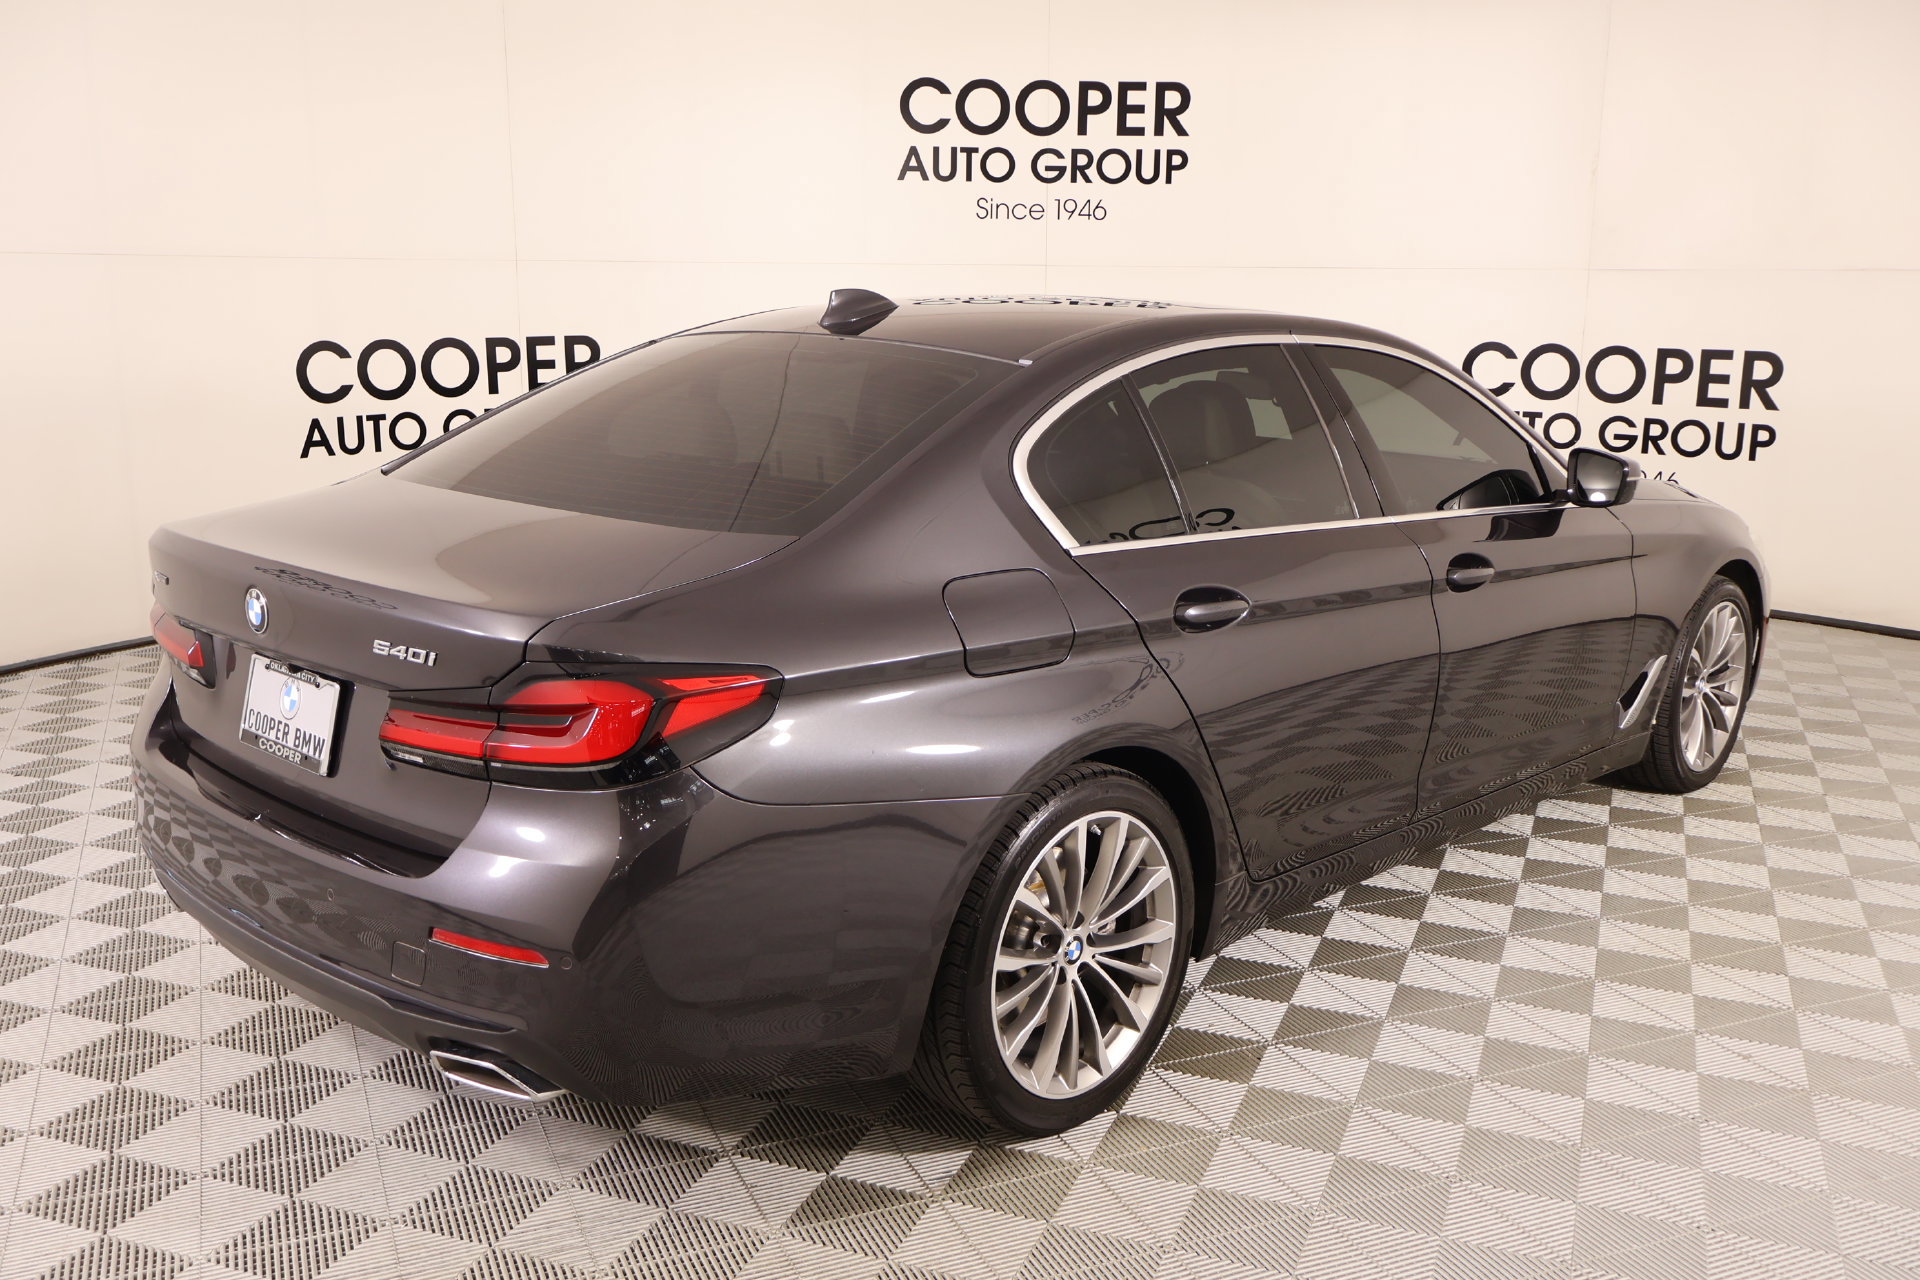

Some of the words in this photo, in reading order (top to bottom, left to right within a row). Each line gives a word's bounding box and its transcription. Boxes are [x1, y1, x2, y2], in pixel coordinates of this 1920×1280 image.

[899, 77, 1192, 137] COOPER
[897, 145, 1016, 183] AUTO
[1030, 147, 1189, 185] GROUP
[976, 197, 1045, 220] Since
[1054, 198, 1107, 221] 1946
[1461, 341, 1784, 411] COOPER
[300, 411, 427, 459] AUTO
[1598, 415, 1777, 462] GROUP
[372, 639, 438, 667] 540i
[301, 671, 317, 684] CITY
[247, 708, 290, 745] COOPER
[293, 727, 326, 758] BMW
[259, 737, 302, 764] COOPER
